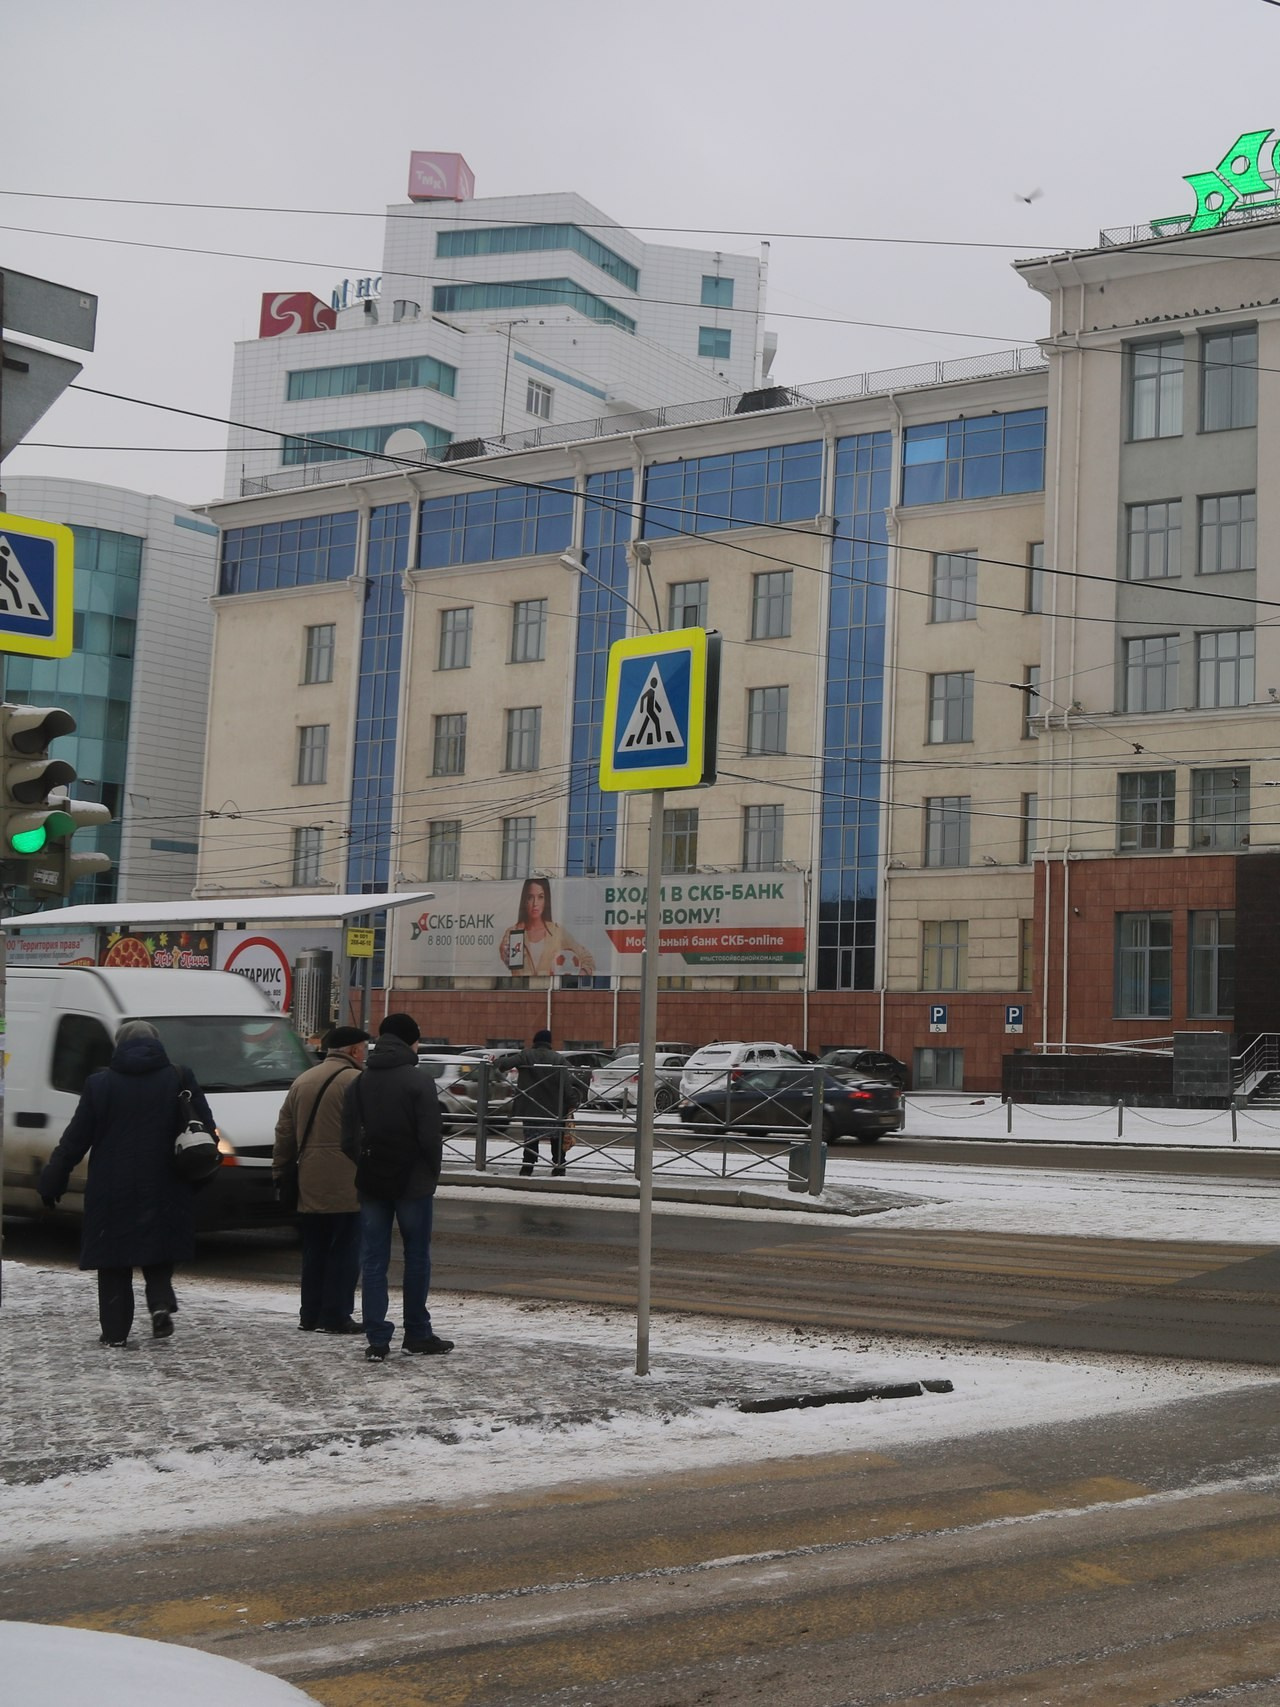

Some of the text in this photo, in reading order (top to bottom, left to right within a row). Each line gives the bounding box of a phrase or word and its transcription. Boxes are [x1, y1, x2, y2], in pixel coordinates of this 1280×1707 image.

[671, 886, 683, 902] В
[688, 883, 785, 902] СКБ-БАНК
[428, 913, 495, 929] СКБ-БАНК
[604, 908, 721, 925] ПО-НВОМУ!
[427, 934, 495, 946] 8 800 1000 600
[625, 933, 785, 947] Мобьный банк СКБ-online
[181, 949, 210, 969] Пицца
[933, 1007, 944, 1023] P
[1008, 1007, 1020, 1023] P
